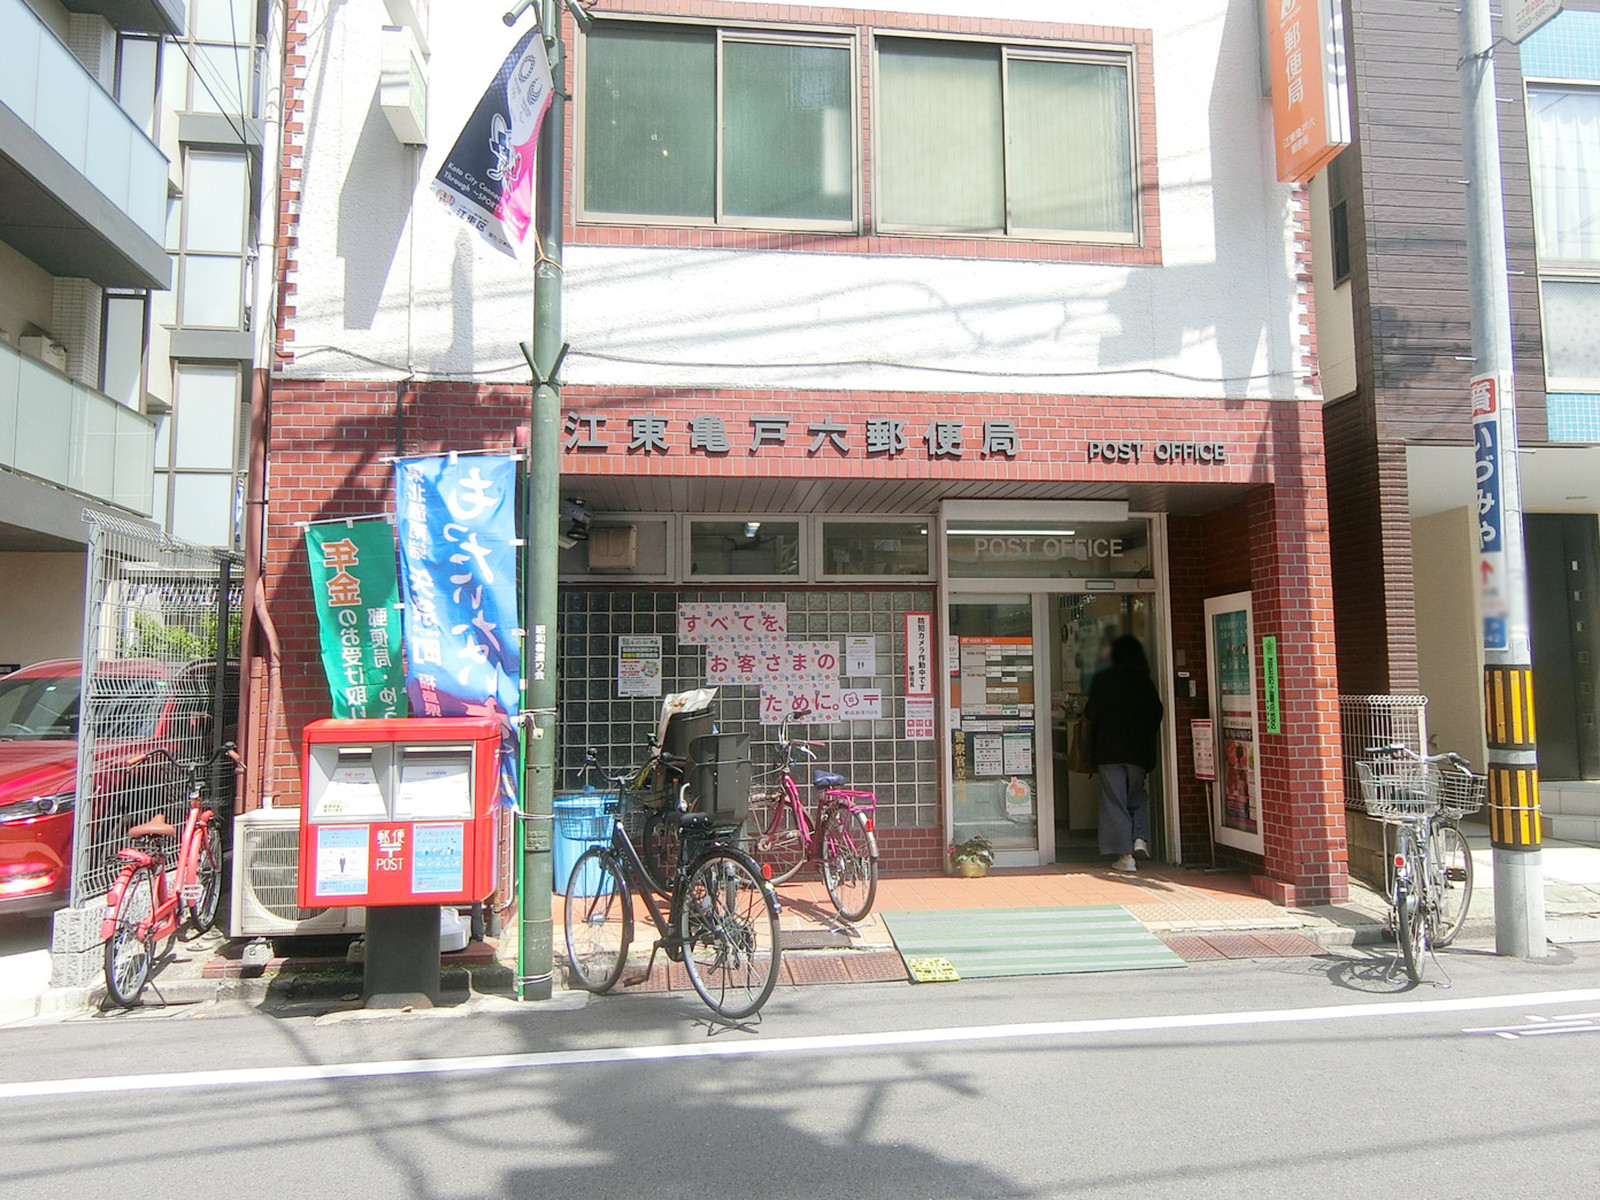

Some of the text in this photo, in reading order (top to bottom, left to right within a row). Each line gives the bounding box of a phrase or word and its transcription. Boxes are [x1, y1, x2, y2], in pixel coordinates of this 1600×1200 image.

[1284, 20, 1304, 111] 郵便局
[444, 171, 471, 193] Through
[447, 162, 464, 176] Koto
[464, 173, 478, 186] City
[1471, 381, 1491, 411] 質
[564, 411, 1019, 456] 江東亀戸六郵便局
[1089, 441, 1226, 461] POST OFFICE
[1473, 427, 1497, 549] いづみや
[974, 538, 1124, 558] POST OFFICE
[683, 614, 785, 633] すべてを、
[710, 653, 836, 673] お客さまの
[917, 617, 926, 691] 防犯カメラ作動中です
[764, 694, 840, 712] ために。
[377, 829, 405, 844] 郵便
[376, 857, 404, 871] POST
